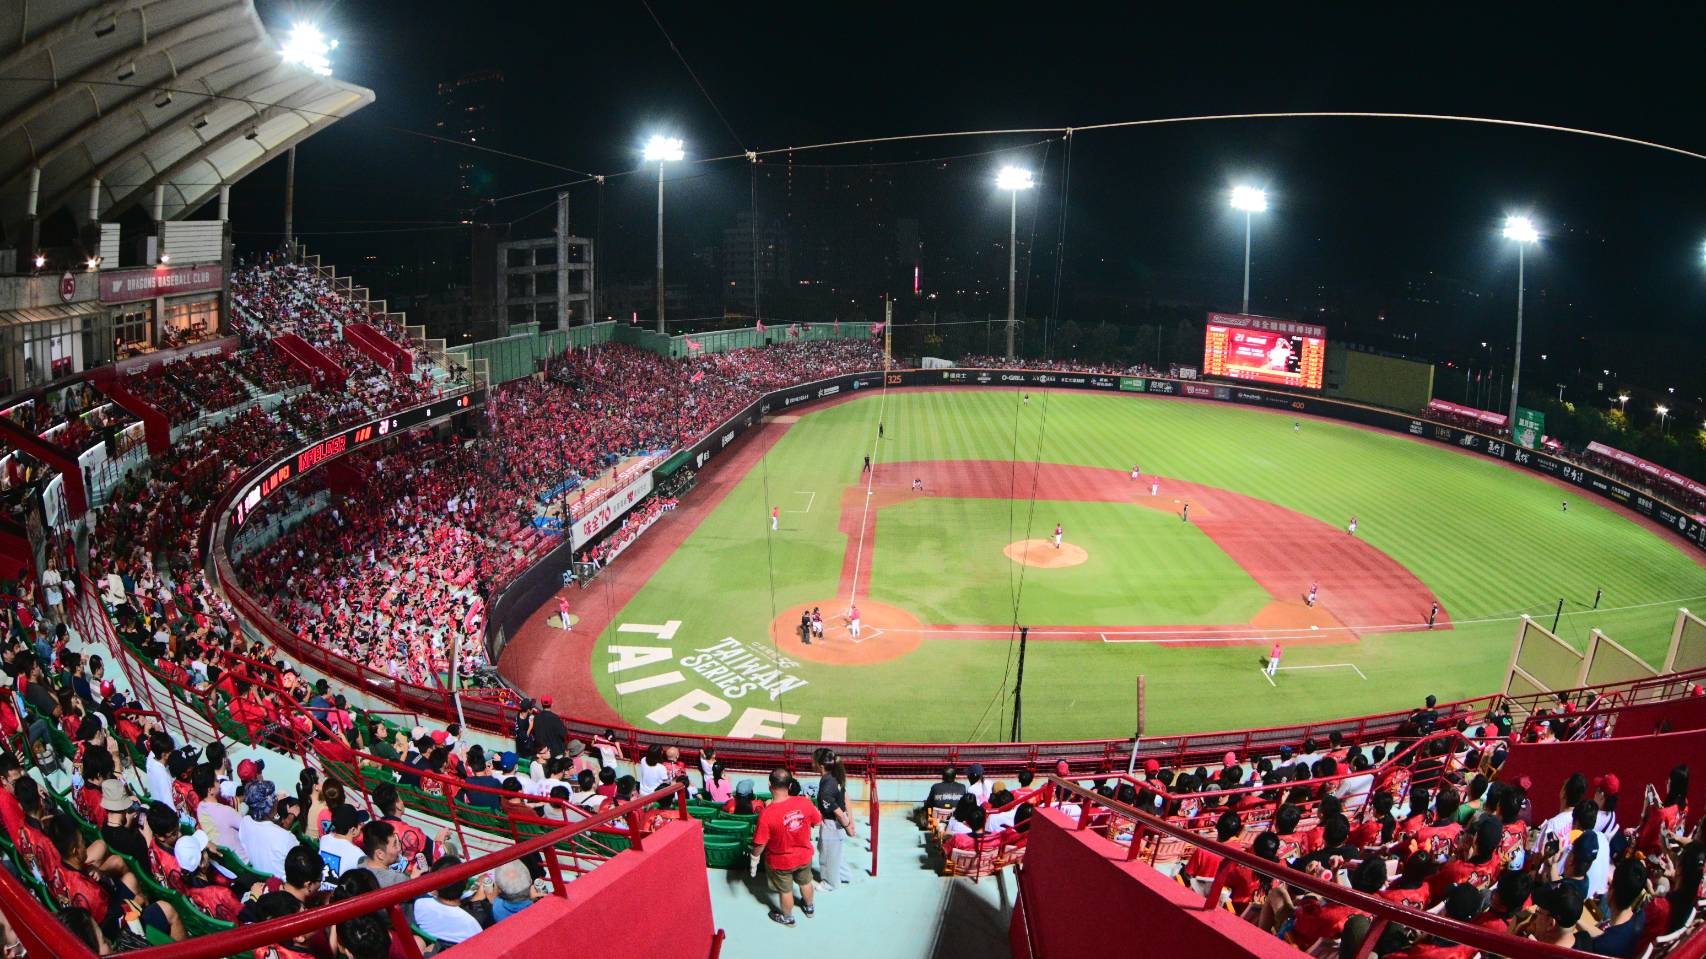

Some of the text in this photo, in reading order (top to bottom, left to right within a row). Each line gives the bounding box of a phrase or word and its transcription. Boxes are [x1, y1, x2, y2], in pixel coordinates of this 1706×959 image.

[127, 277, 156, 291] DRAGONS
[157, 274, 192, 288] BASEBALL
[192, 271, 210, 284] CLUB
[887, 375, 902, 384] 325
[1291, 401, 1304, 409] 400
[378, 419, 389, 435] 21
[298, 434, 346, 473] INFIELDER
[680, 653, 758, 699] SERIES
[695, 637, 809, 701] TAIWAN
